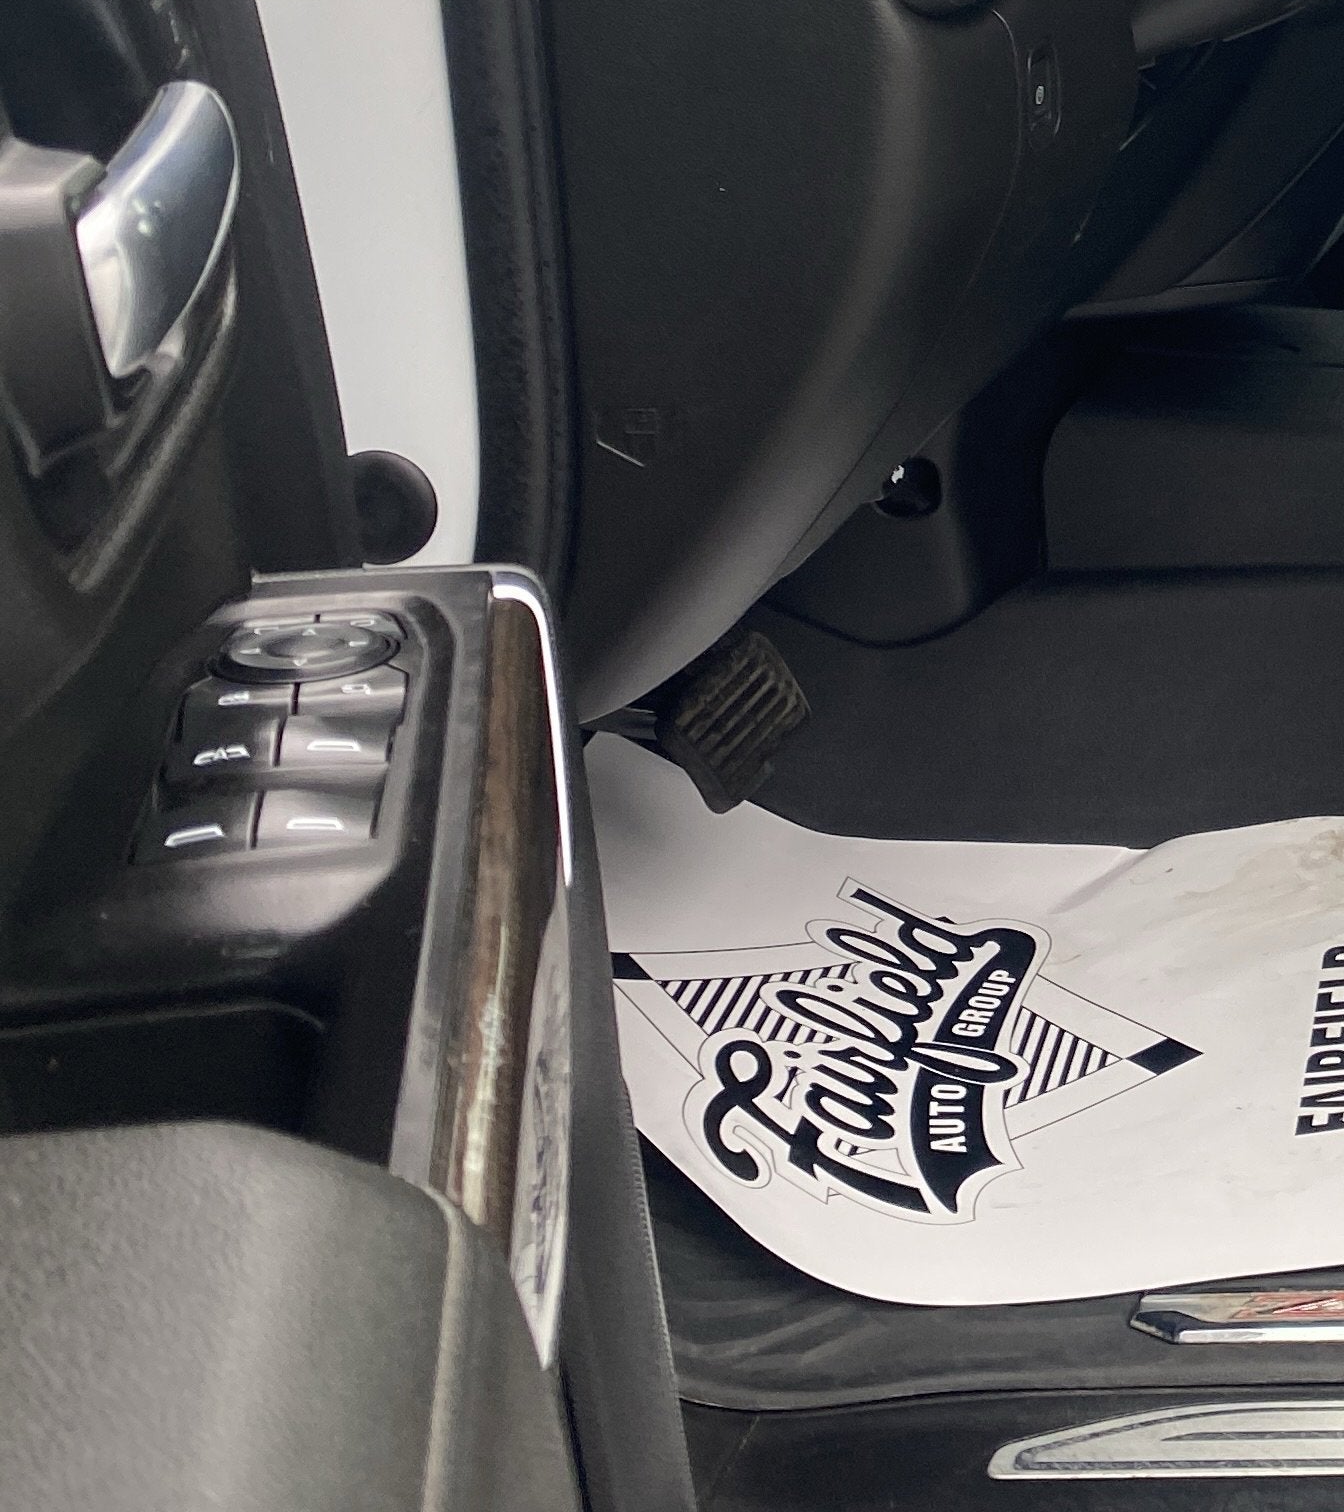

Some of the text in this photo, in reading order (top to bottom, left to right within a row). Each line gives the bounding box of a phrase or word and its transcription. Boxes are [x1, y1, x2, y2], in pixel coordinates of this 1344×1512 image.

[704, 888, 1018, 1214] Fairfield
[928, 969, 1017, 1153] AUTO GROUP
